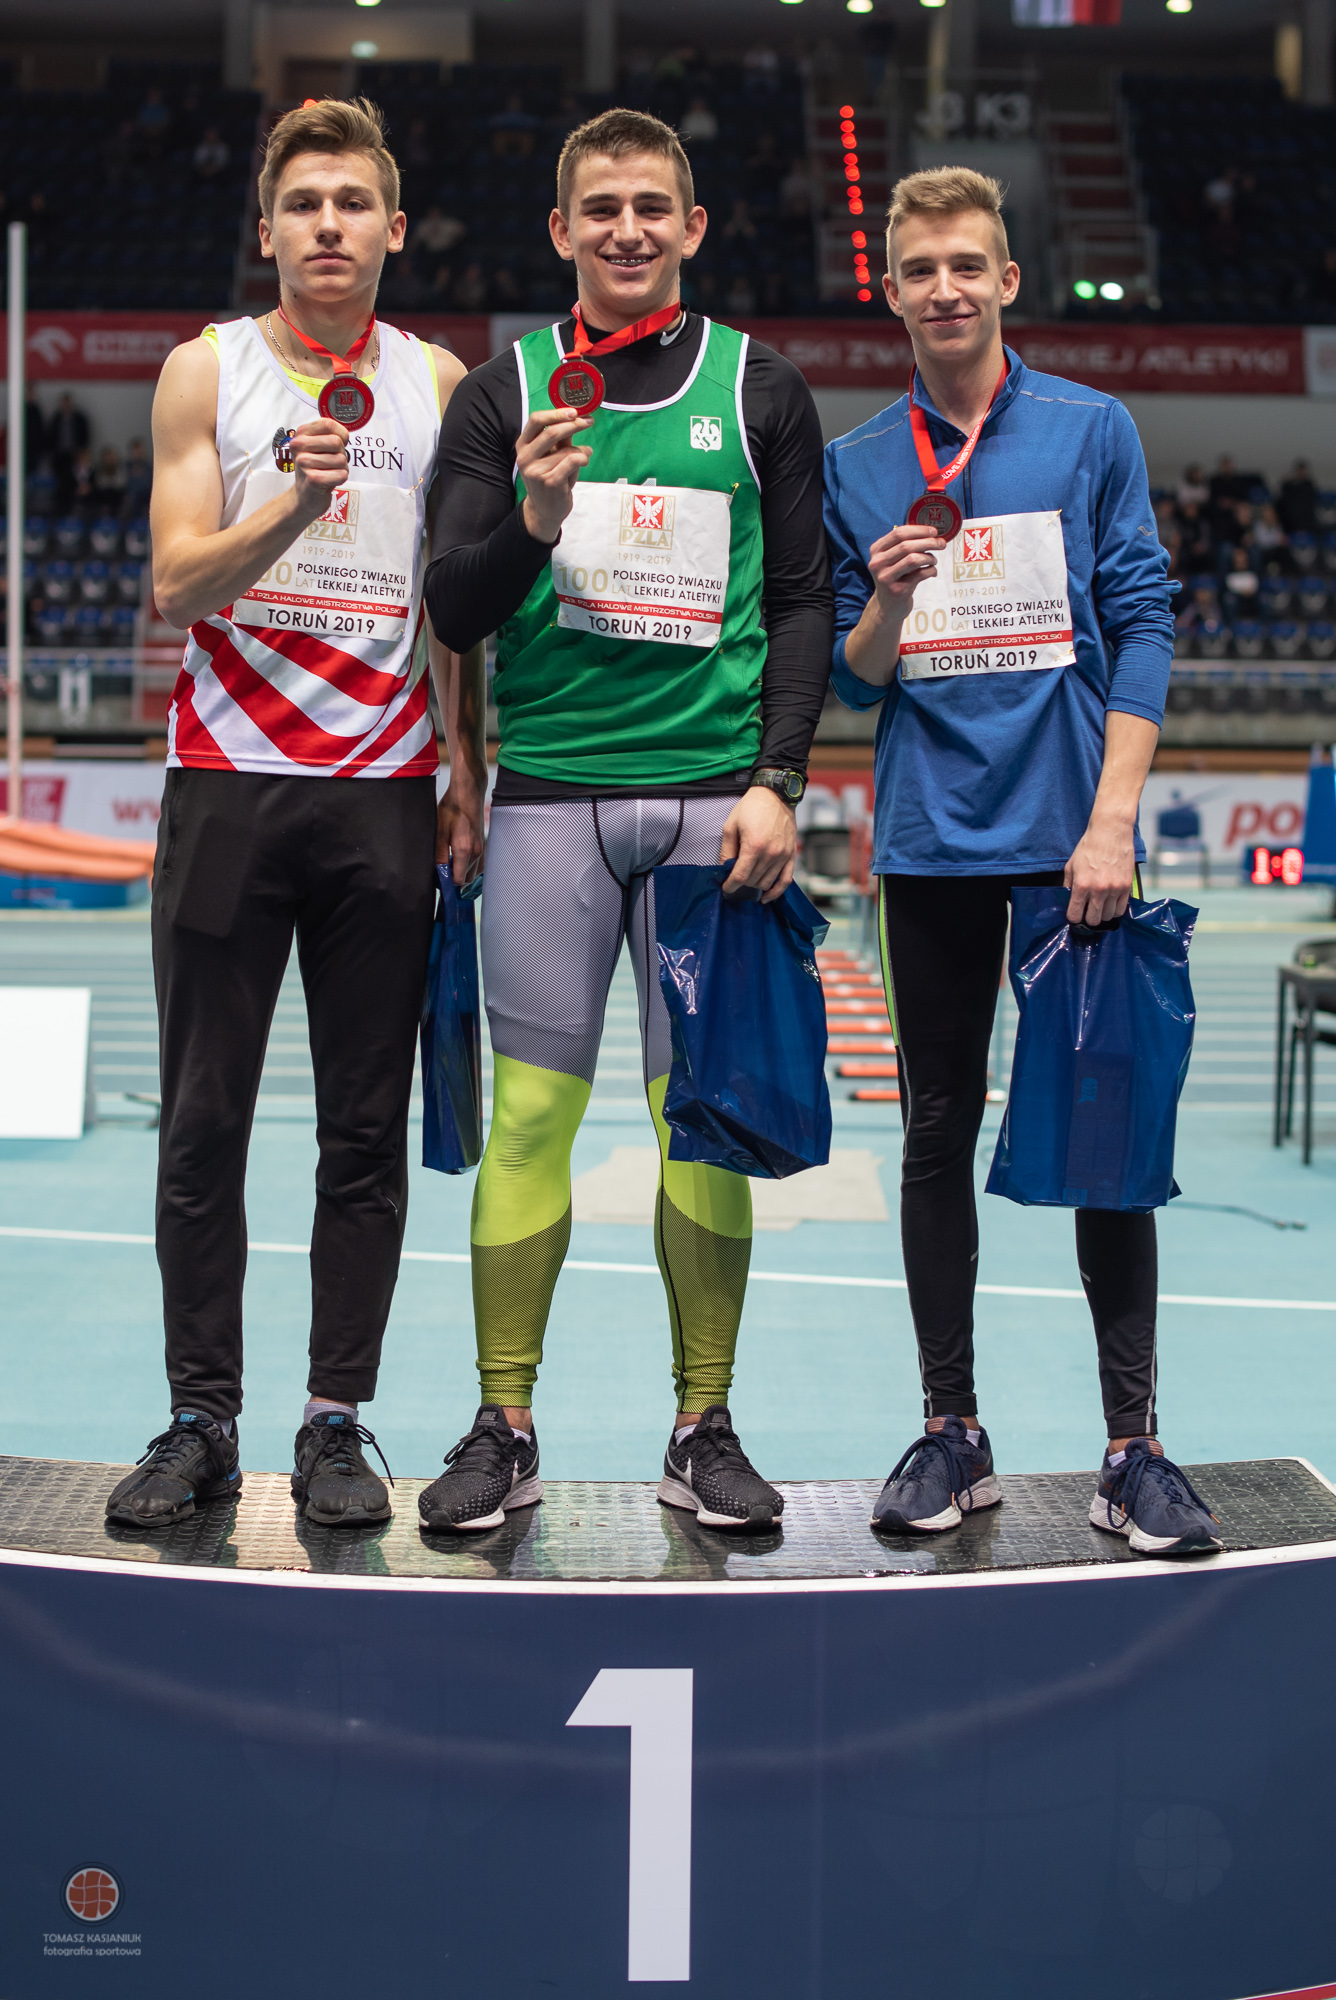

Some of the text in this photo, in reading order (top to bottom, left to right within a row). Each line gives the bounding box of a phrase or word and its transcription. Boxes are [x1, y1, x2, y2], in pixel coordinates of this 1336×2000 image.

[307, 523, 353, 542] PZLA
[621, 528, 669, 547] PZLA
[297, 563, 358, 578] POLSKIEGO
[361, 571, 406, 585] ZWIĄZKU
[558, 566, 722, 593] 100 POLSKIEGO ZWIĄZKU
[955, 563, 1001, 580] PZLA
[295, 577, 405, 599] LAT LEKKIEJ ATLETYKI
[611, 583, 721, 604] LAT LEKKIEJ ATLETYKI
[257, 592, 279, 601] PZLA
[280, 595, 315, 606] HALOWE
[315, 599, 374, 612] MISTRZOSTWA
[374, 605, 402, 615] POLSKI
[597, 603, 632, 612] HALOWE
[633, 605, 691, 618] MISTRZOSTWA
[692, 611, 715, 620] POLSKI
[950, 602, 1013, 617] POLSKIEGO
[1016, 599, 1063, 613] ZWIĄZKU
[267, 608, 375, 634] TORUŃ 2019
[588, 615, 692, 640] TORUŃ 2019
[951, 612, 1064, 632] LAT LEKKIEJ ATLETYKI
[918, 642, 938, 650] PZLA
[939, 638, 973, 648] HALOWE
[974, 634, 1034, 646] MISTRZOSTWA
[1035, 633, 1062, 642] POLSKI
[930, 649, 1038, 672] TORUŃ 2019
[327, 1415, 345, 1425] NIKE
[480, 1410, 498, 1421] NIKE
[565, 1668, 693, 1981] 1
